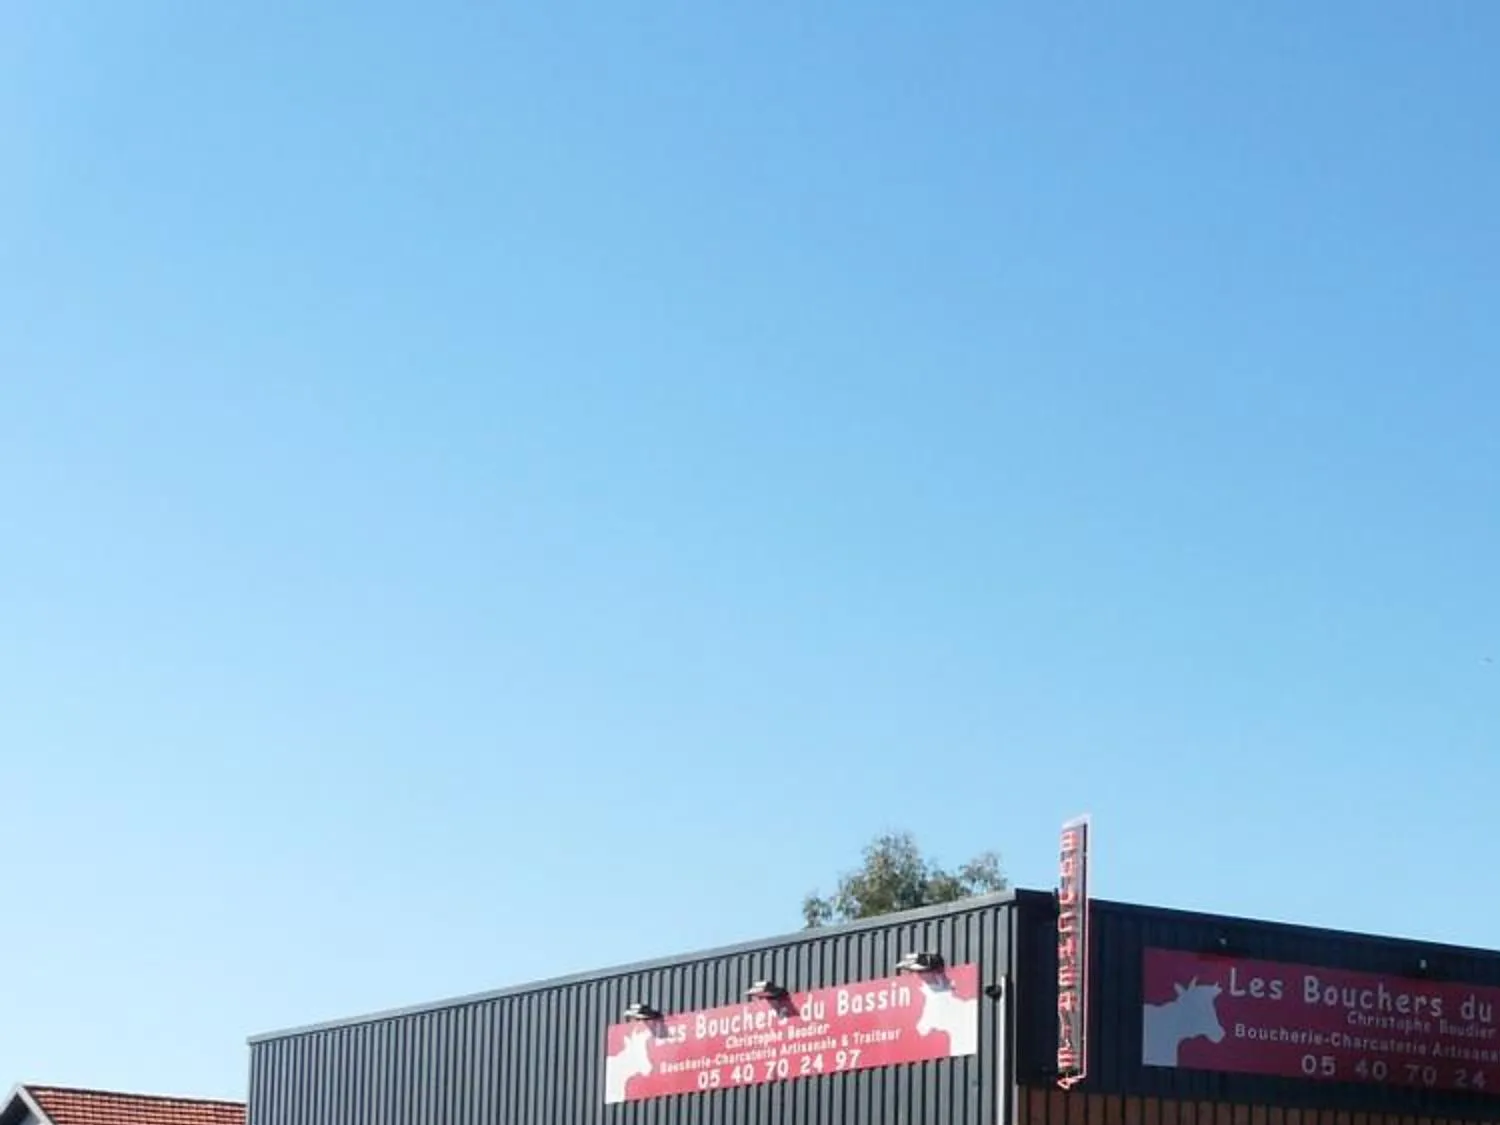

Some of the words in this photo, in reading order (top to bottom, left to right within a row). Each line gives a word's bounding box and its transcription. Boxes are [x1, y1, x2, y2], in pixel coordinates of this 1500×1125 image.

[800, 992, 826, 1022] du
[836, 980, 912, 1017] Bassin
[1229, 966, 1284, 1001] Les
[1303, 974, 1443, 1018] Bouchers
[1460, 993, 1493, 1023] du
[1234, 1022, 1428, 1056] Boucherie-Charcuterie
[697, 1067, 721, 1090] 05
[730, 1062, 754, 1084] 40
[764, 1058, 790, 1080] 70
[800, 1053, 825, 1075] 24
[835, 1048, 862, 1071] 97
[1301, 1053, 1337, 1077] 05
[1354, 1056, 1388, 1081] 40
[1404, 1063, 1438, 1087] 70
[1456, 1069, 1487, 1090] 24
